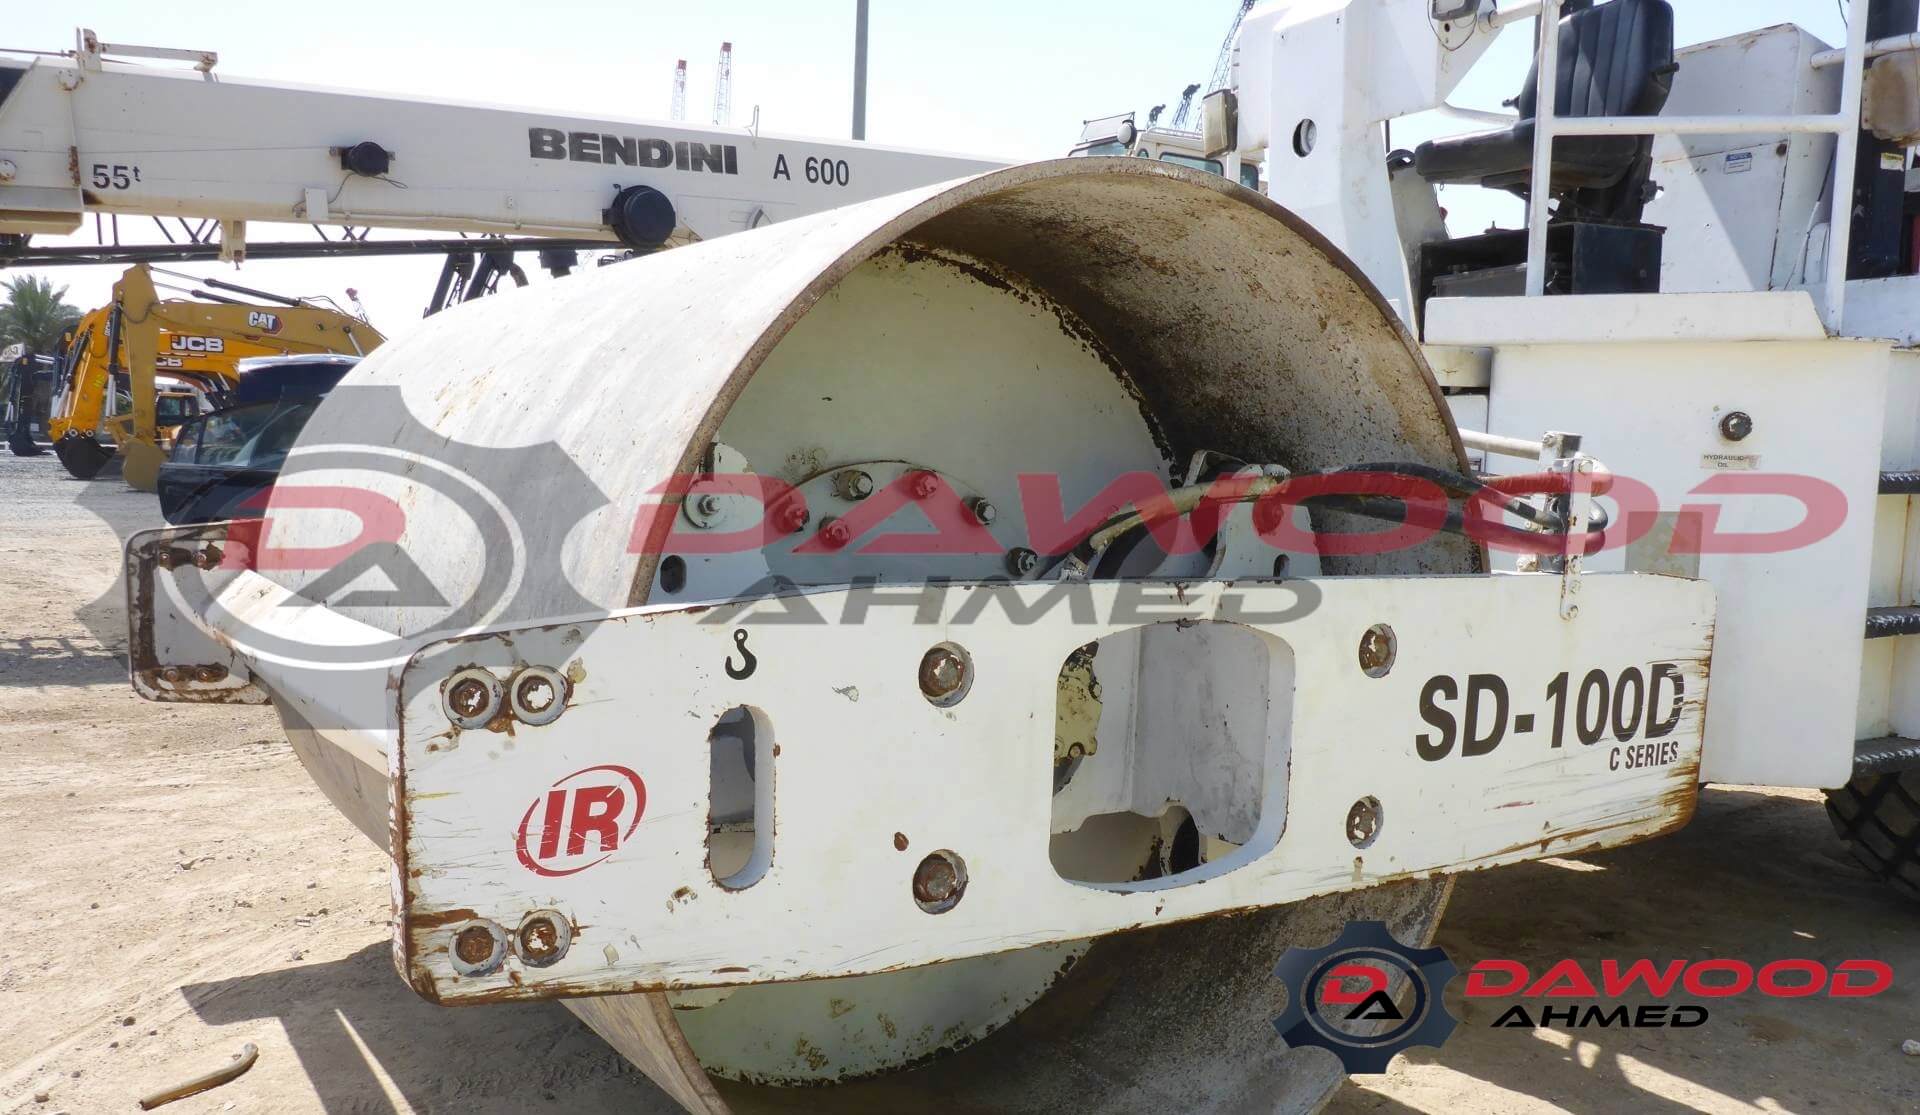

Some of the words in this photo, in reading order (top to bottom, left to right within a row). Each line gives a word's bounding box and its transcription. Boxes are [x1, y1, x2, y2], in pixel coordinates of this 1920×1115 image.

[529, 127, 738, 175] BENDINI
[773, 153, 791, 181] A
[805, 155, 850, 187] 600
[248, 311, 276, 330] CAT
[171, 336, 224, 353] JCB
[155, 357, 184, 368] CB
[1416, 662, 1686, 762] SD-100D
[1608, 745, 1621, 772] C
[1624, 741, 1679, 769] SERIES
[538, 785, 626, 859] IR
